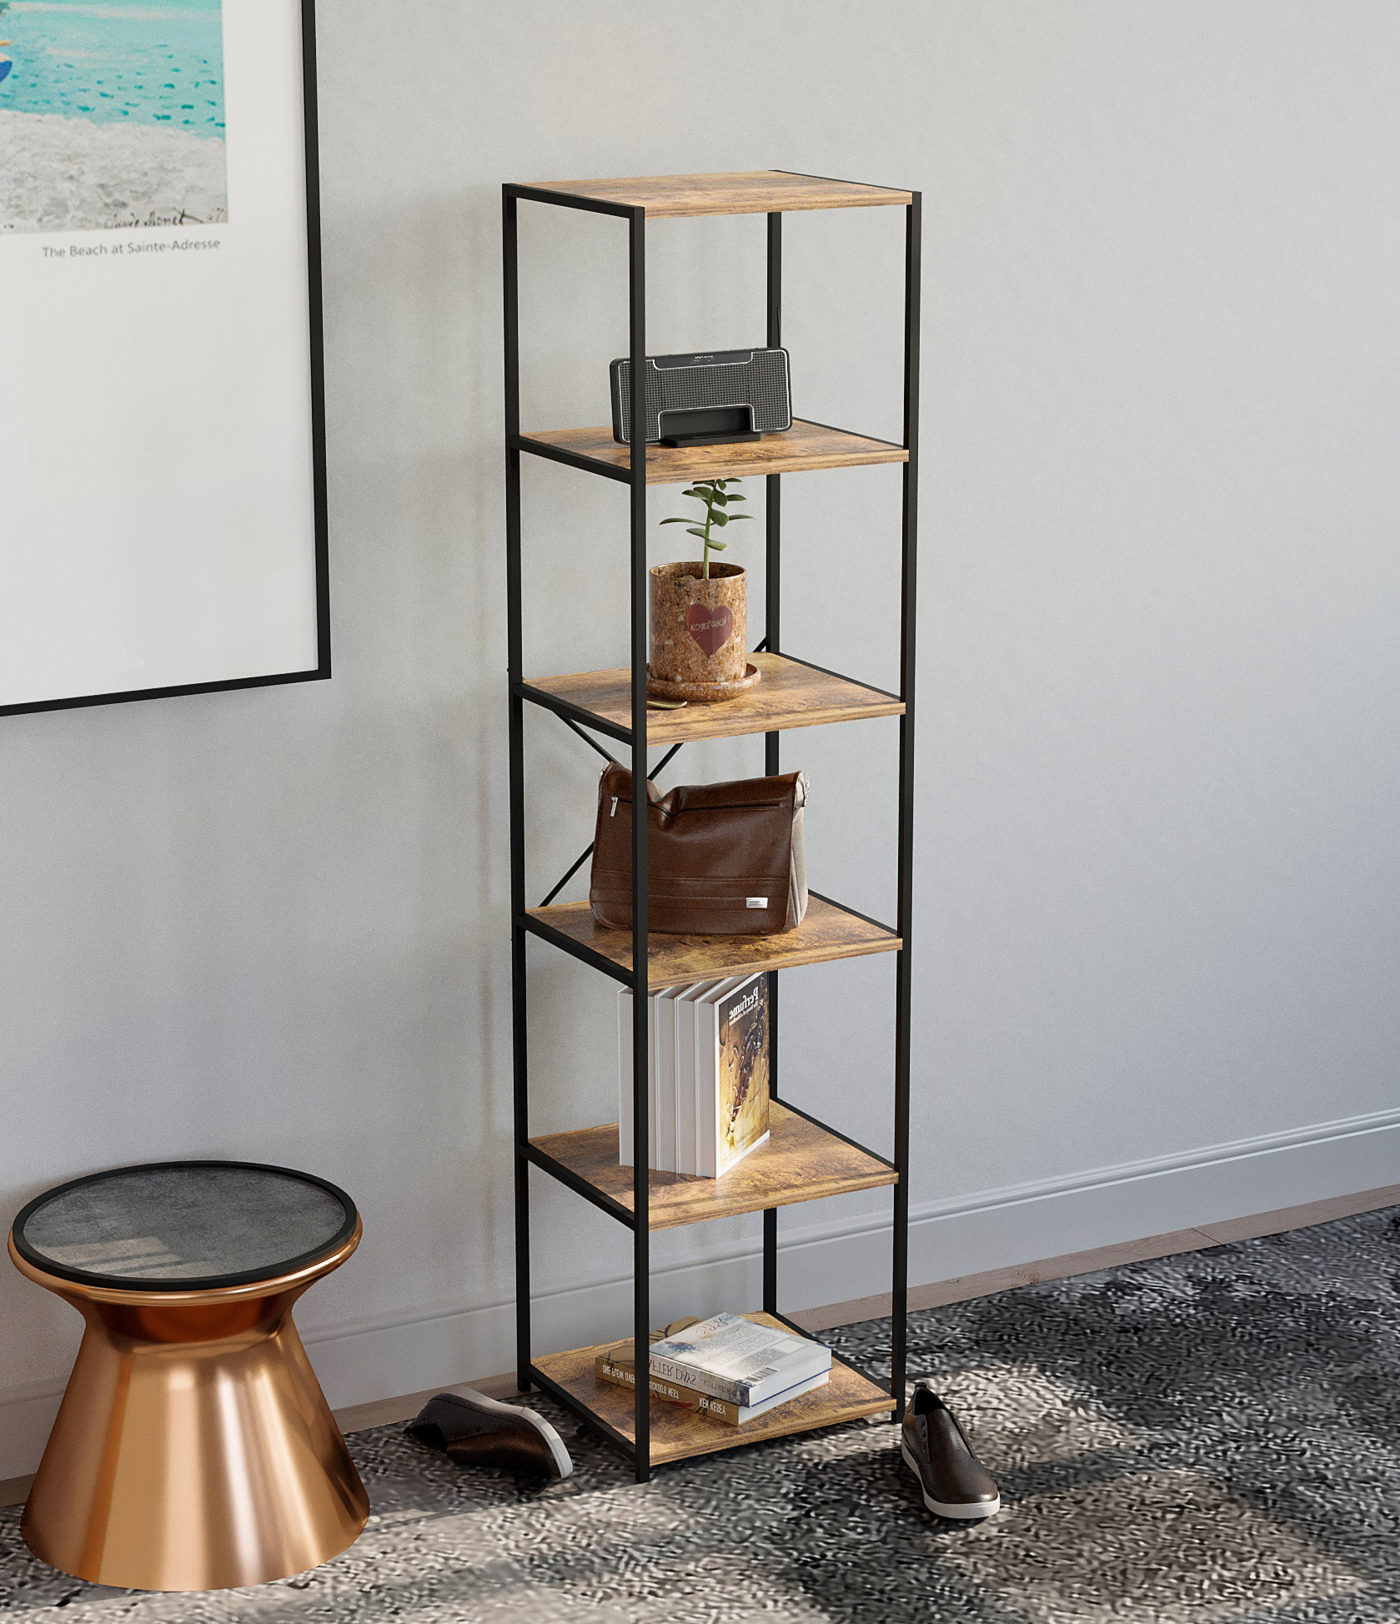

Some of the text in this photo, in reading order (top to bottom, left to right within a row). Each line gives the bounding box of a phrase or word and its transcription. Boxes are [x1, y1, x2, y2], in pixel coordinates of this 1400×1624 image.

[42, 240, 221, 258] The Beach at Sainte-Adresse
